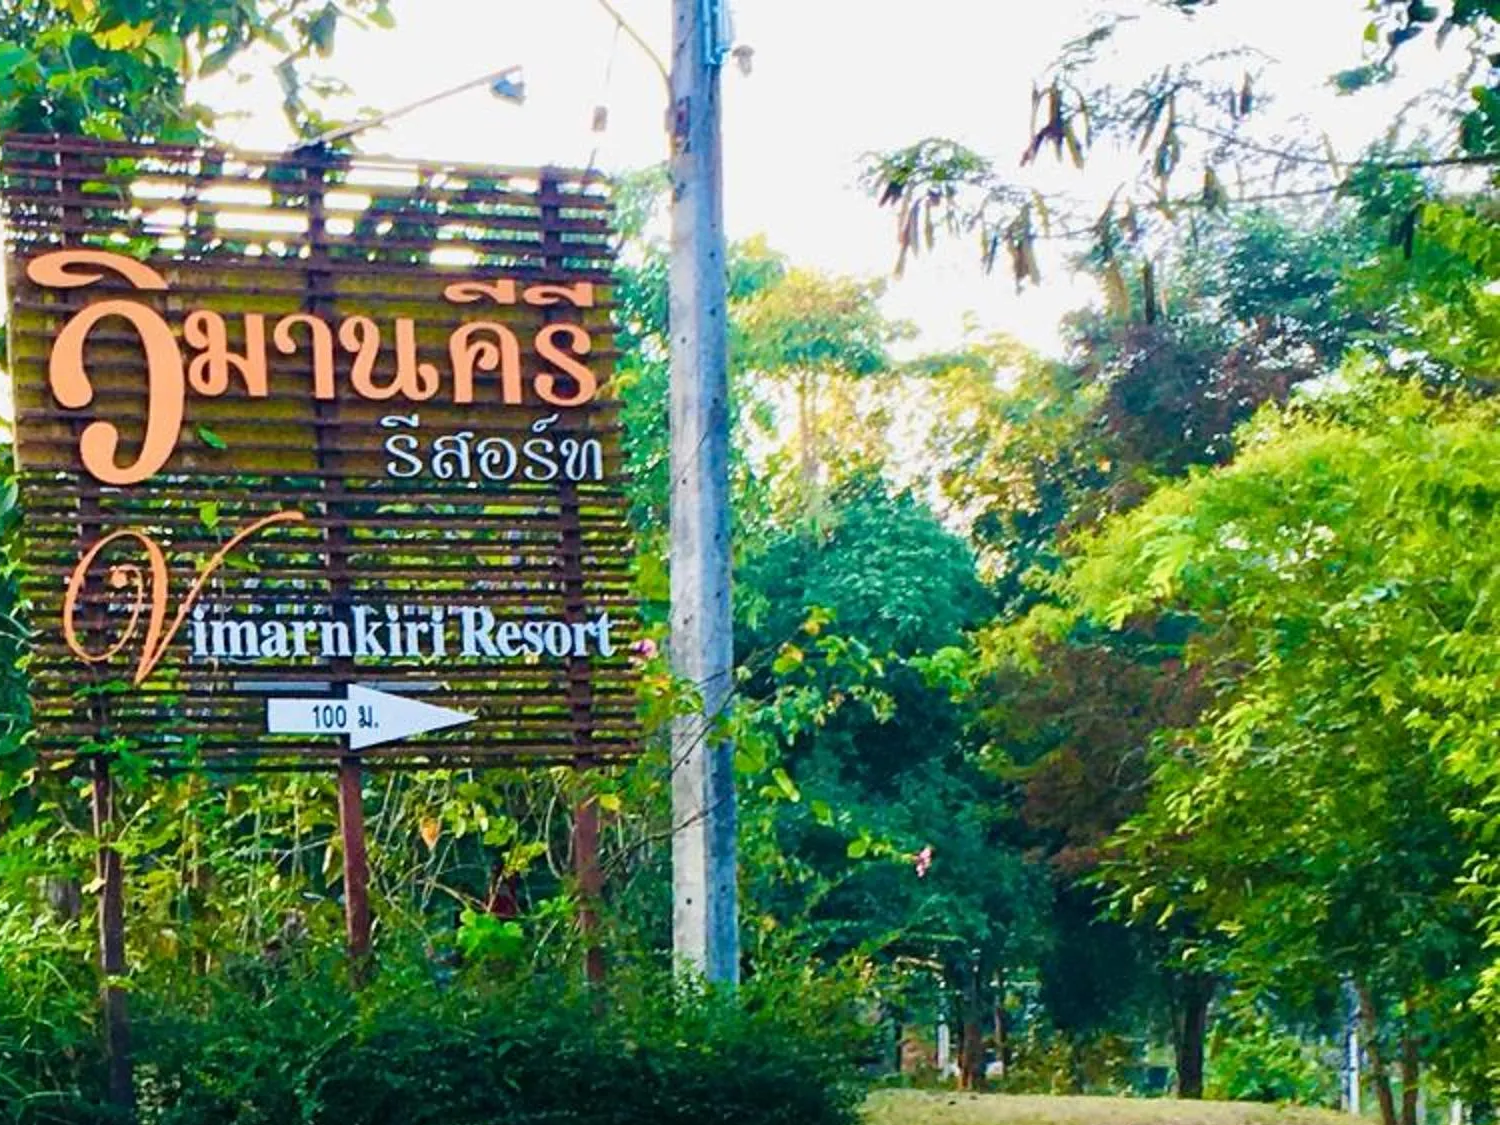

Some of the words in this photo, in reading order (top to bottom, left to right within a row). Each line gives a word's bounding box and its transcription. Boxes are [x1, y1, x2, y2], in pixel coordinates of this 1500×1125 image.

[27, 249, 597, 484] วิมานคีรี
[380, 413, 604, 481] รีสอร์ท
[63, 511, 445, 685] Vimarnkiri
[458, 605, 617, 658] Resort
[312, 704, 347, 729] 100
[358, 704, 379, 729] ม.
